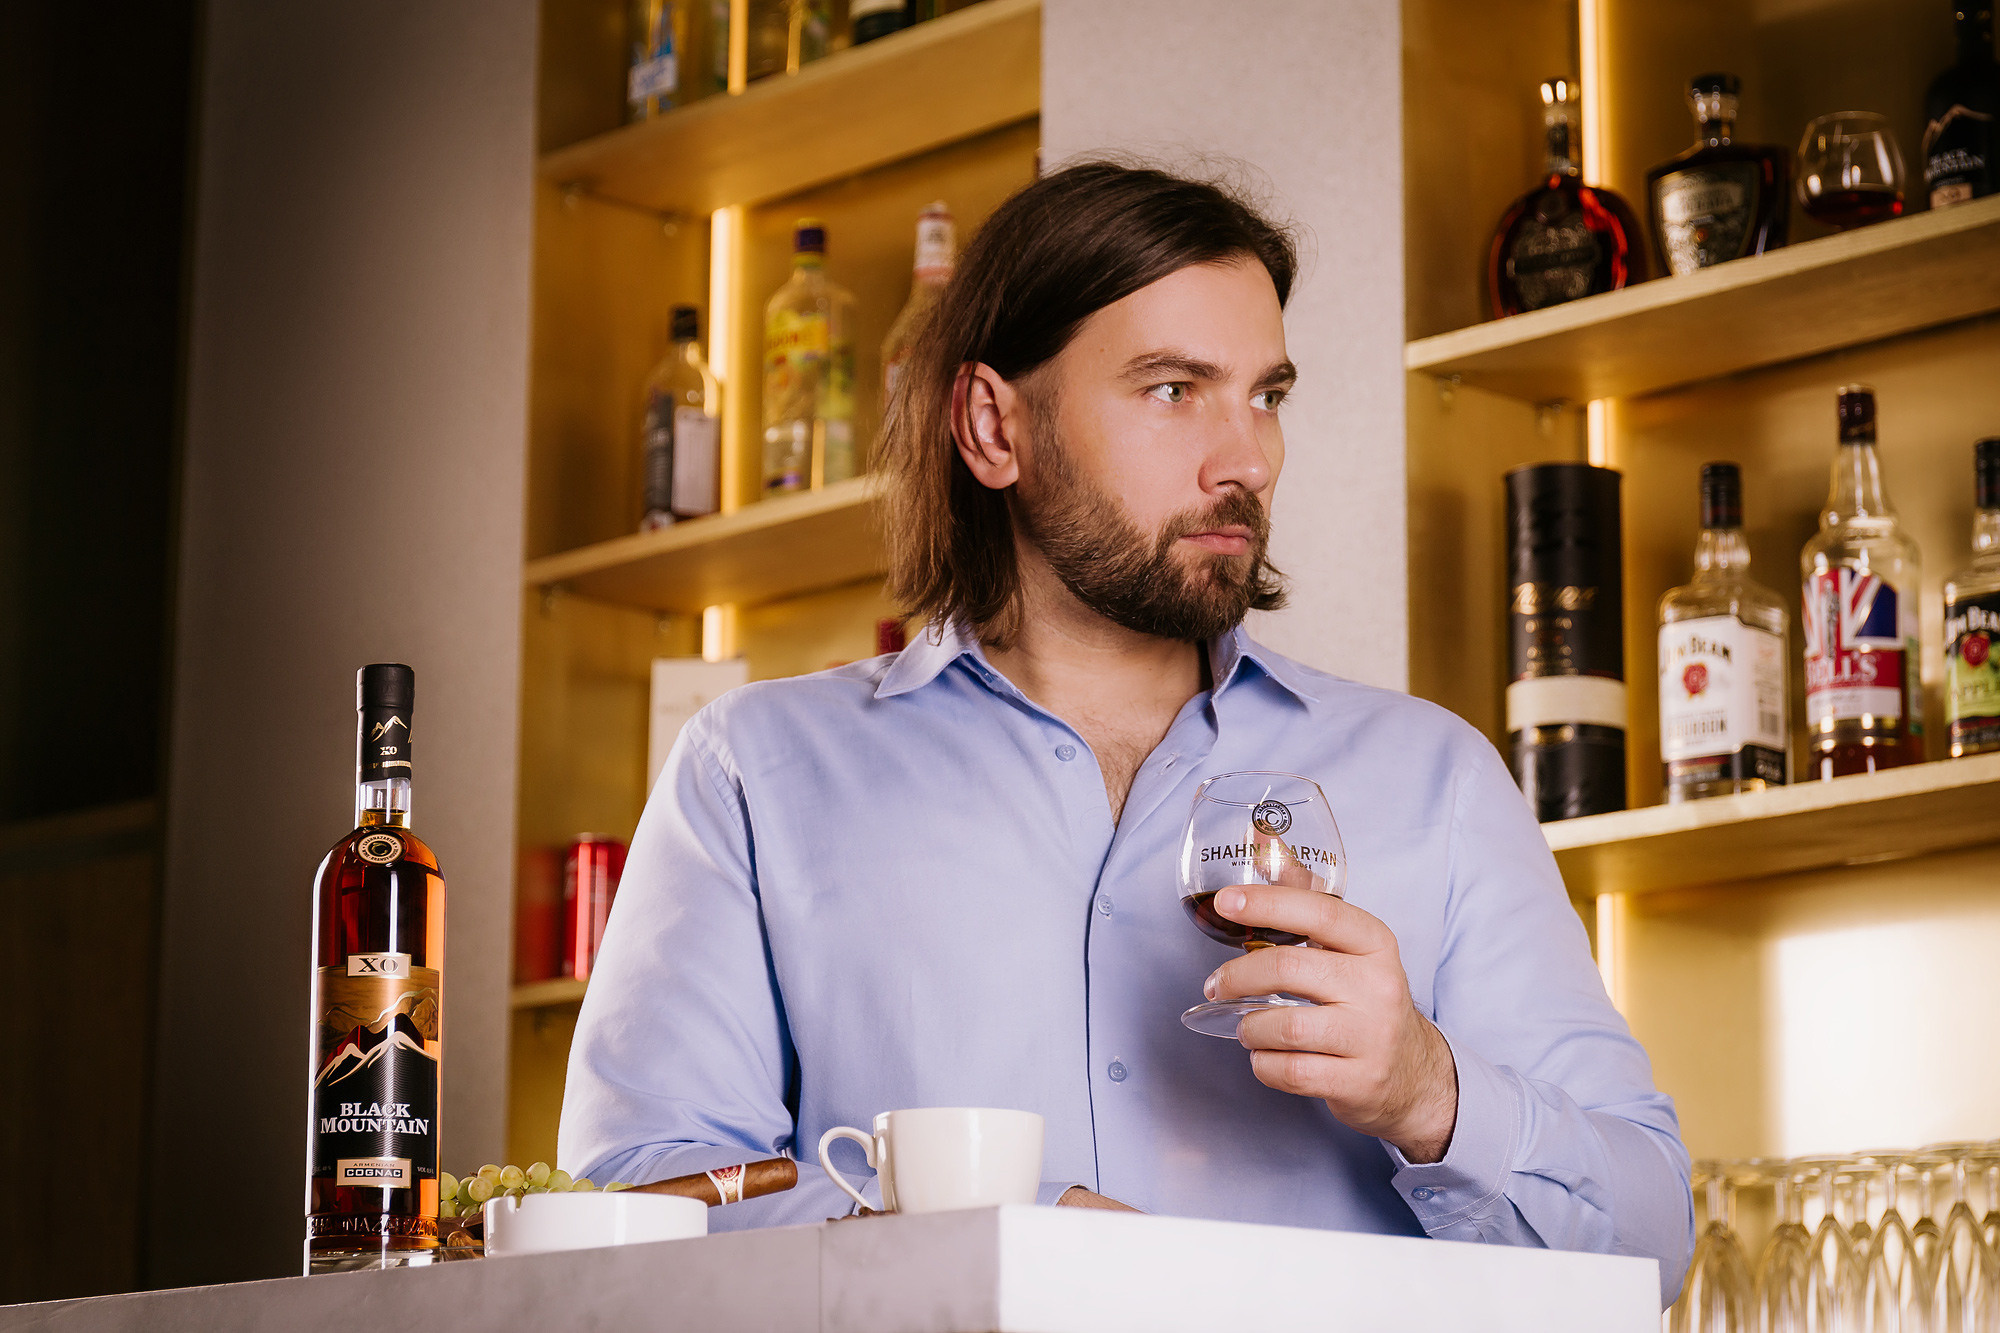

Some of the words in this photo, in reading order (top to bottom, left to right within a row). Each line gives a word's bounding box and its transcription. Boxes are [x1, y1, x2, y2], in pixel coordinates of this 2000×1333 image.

[1967, 605, 2000, 632] BEA
[380, 746, 398, 755] XO
[358, 957, 399, 974] XO
[340, 1102, 411, 1118] BLACK
[320, 1117, 429, 1136] MOUNTAIN
[346, 1168, 402, 1178] COGNAC
